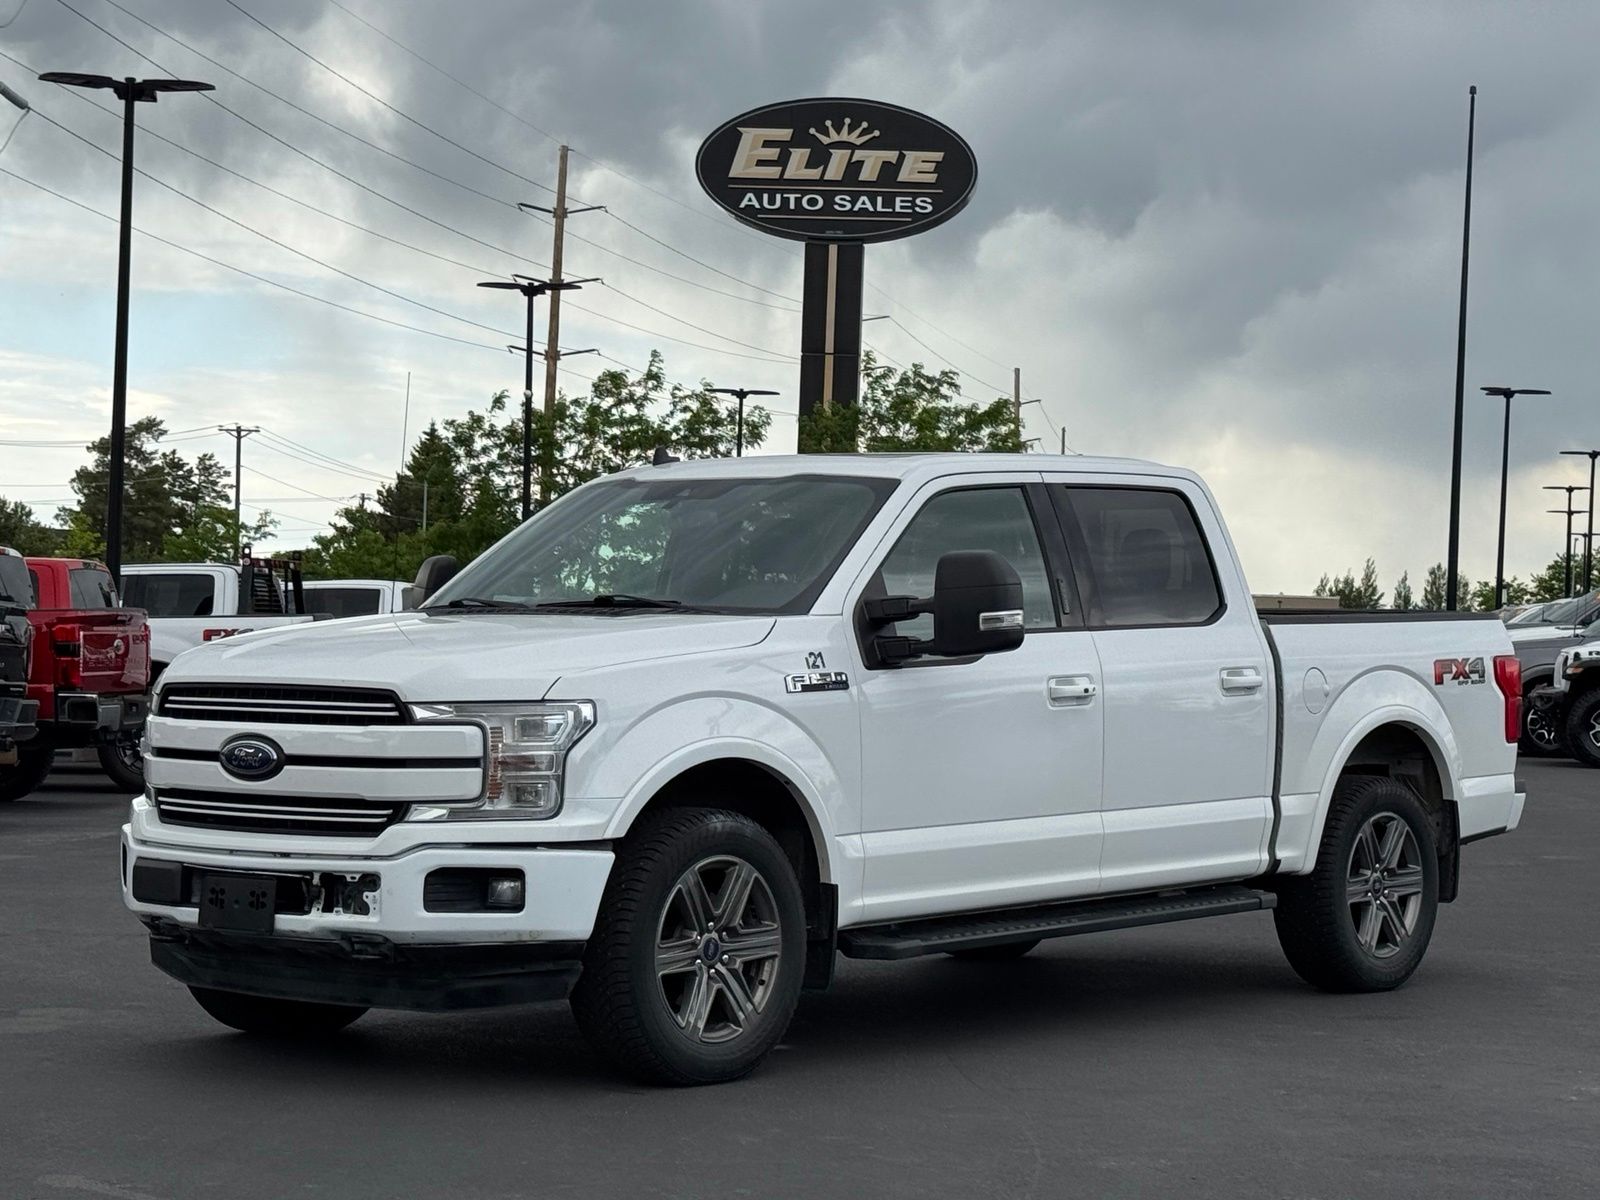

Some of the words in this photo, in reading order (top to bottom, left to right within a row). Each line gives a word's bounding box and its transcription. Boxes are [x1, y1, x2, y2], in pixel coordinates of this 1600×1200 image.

[728, 127, 945, 183] ELITE
[738, 192, 824, 211] AUTO
[833, 195, 933, 213] SALES
[1433, 657, 1486, 685] FX4
